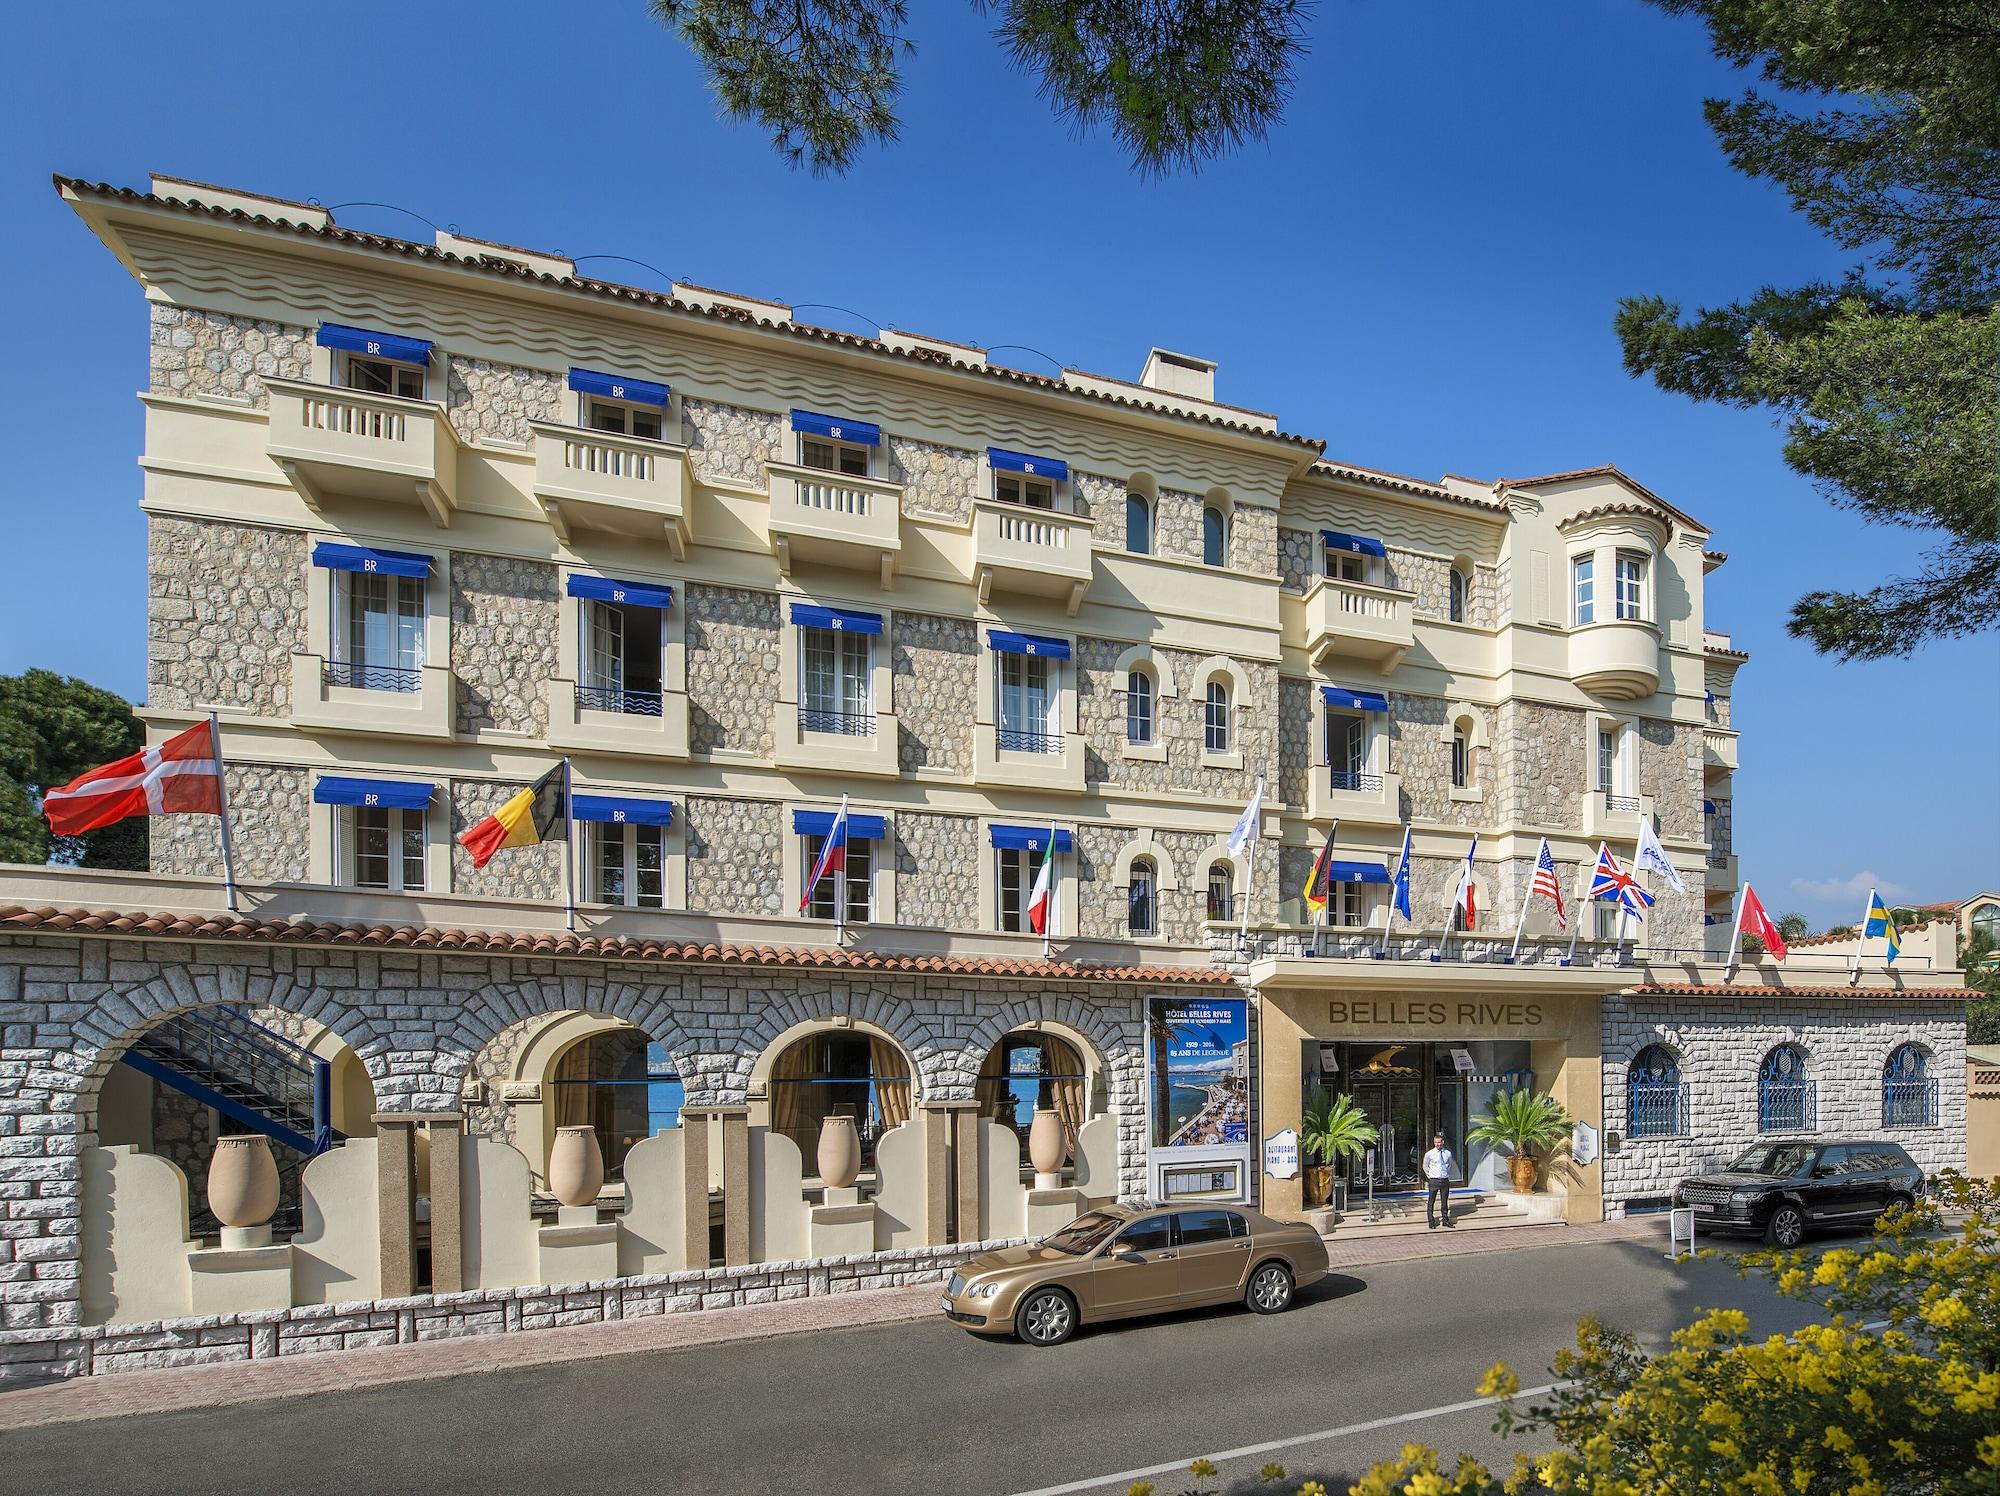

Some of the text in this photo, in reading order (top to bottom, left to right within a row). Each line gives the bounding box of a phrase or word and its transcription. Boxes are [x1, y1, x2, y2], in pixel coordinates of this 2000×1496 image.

[368, 342, 380, 355] BR
[613, 386, 625, 399] BR
[831, 426, 842, 439] BR
[1025, 462, 1035, 474] BR
[1353, 543, 1361, 553] BR
[364, 559, 377, 572] BR
[613, 590, 625, 602] BR
[831, 618, 843, 630] BR
[1026, 643, 1036, 655] BR
[1353, 698, 1362, 709] BR
[364, 793, 378, 806] BR
[613, 810, 626, 823] BR
[1028, 839, 1038, 851] BR
[1353, 872, 1363, 882] BR
[1166, 1009, 1232, 1018] HÔTEL BELLES RIVES
[1329, 1001, 1542, 1026] BELLES RIVES
[1185, 1041, 1199, 1049] 1929
